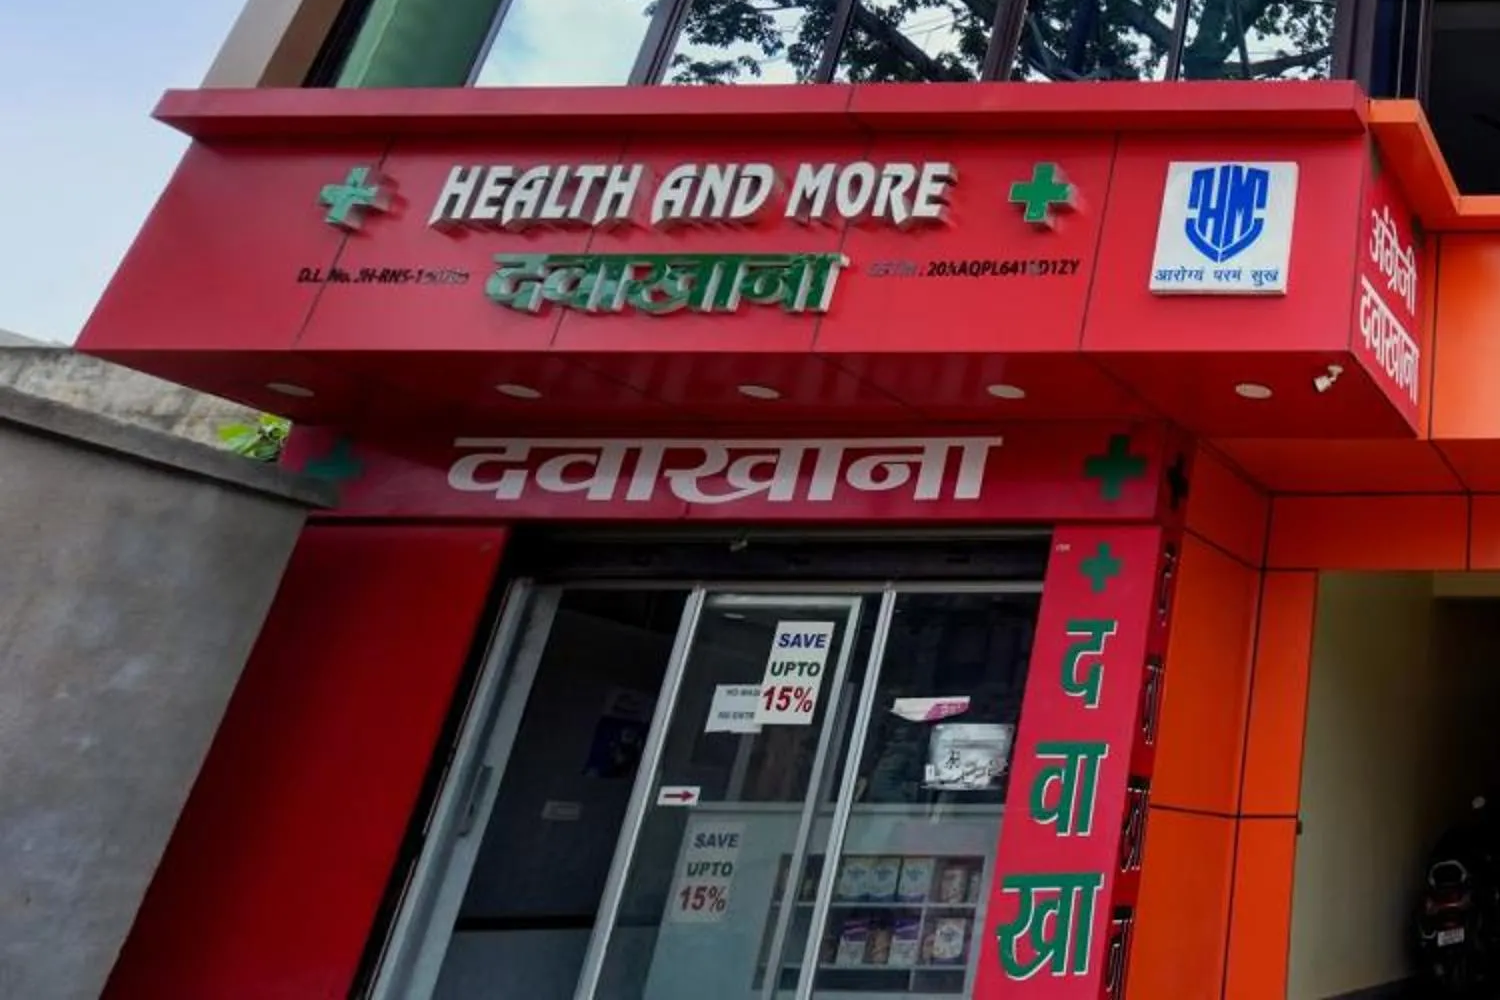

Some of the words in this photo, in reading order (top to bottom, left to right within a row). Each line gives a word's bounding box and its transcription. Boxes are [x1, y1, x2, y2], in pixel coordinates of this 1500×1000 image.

[428, 164, 644, 230] HEALTH
[651, 163, 779, 227] AND
[785, 161, 957, 228] MORE
[485, 252, 849, 314] दवाखाना
[1360, 273, 1419, 405] दवाखाना
[446, 436, 1003, 505] दवाखाना
[779, 633, 829, 649] SAVE
[770, 661, 821, 677] UPTO
[763, 686, 814, 713] 15%
[694, 832, 740, 849] SAVE
[686, 861, 734, 878] UPTO
[679, 885, 727, 914] 15%
